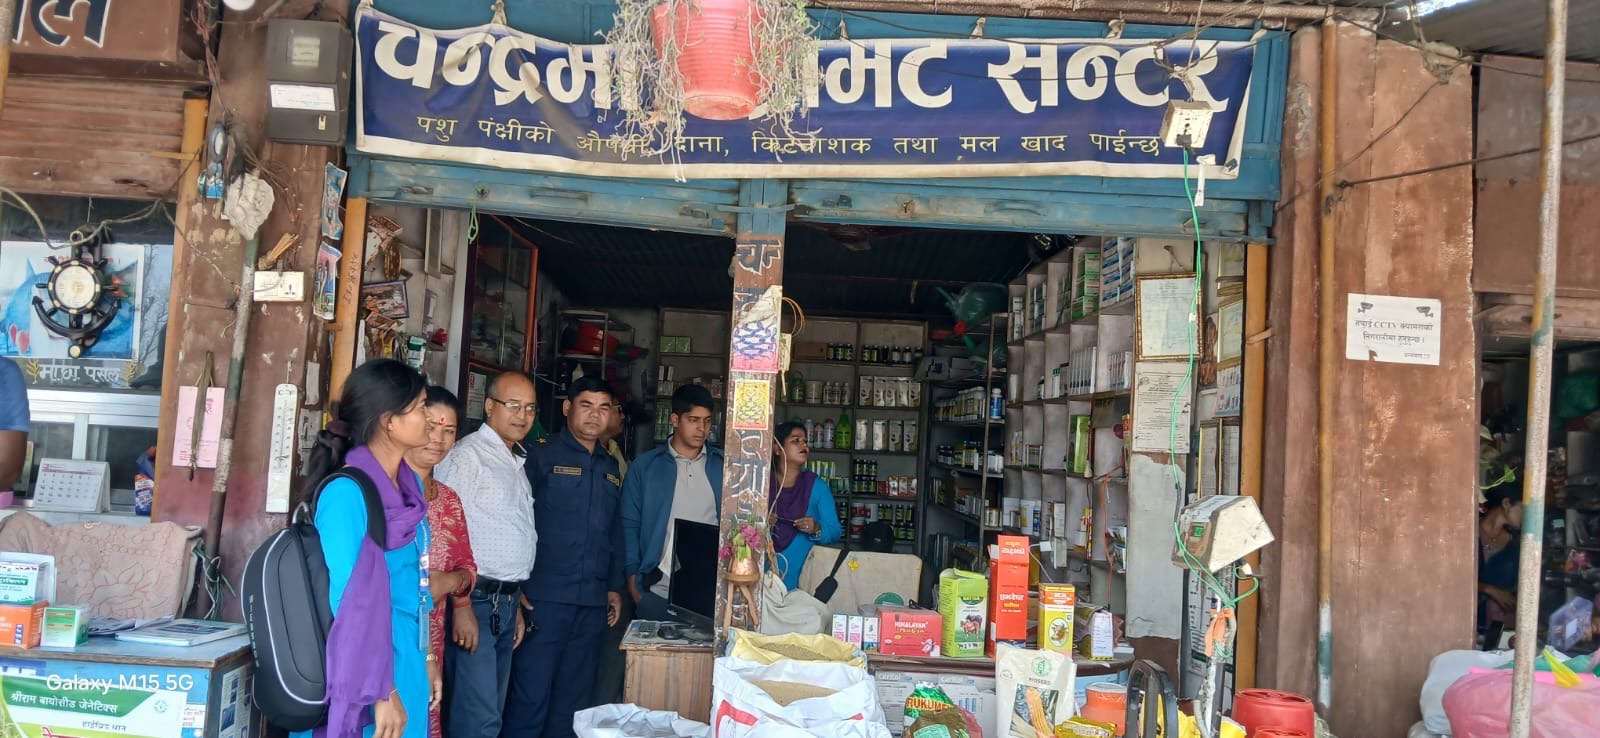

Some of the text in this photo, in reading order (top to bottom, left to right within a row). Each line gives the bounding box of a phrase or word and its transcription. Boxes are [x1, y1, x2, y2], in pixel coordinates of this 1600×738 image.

[416, 116, 458, 142] पशु
[477, 117, 555, 145] पंक्षीको
[893, 137, 938, 154] तथा
[960, 135, 1000, 153] मल
[1021, 134, 1068, 152] खाद
[1374, 321, 1398, 329] CCTV
[83, 366, 120, 383] पसल
[11, 691, 36, 704] श्रीराम
